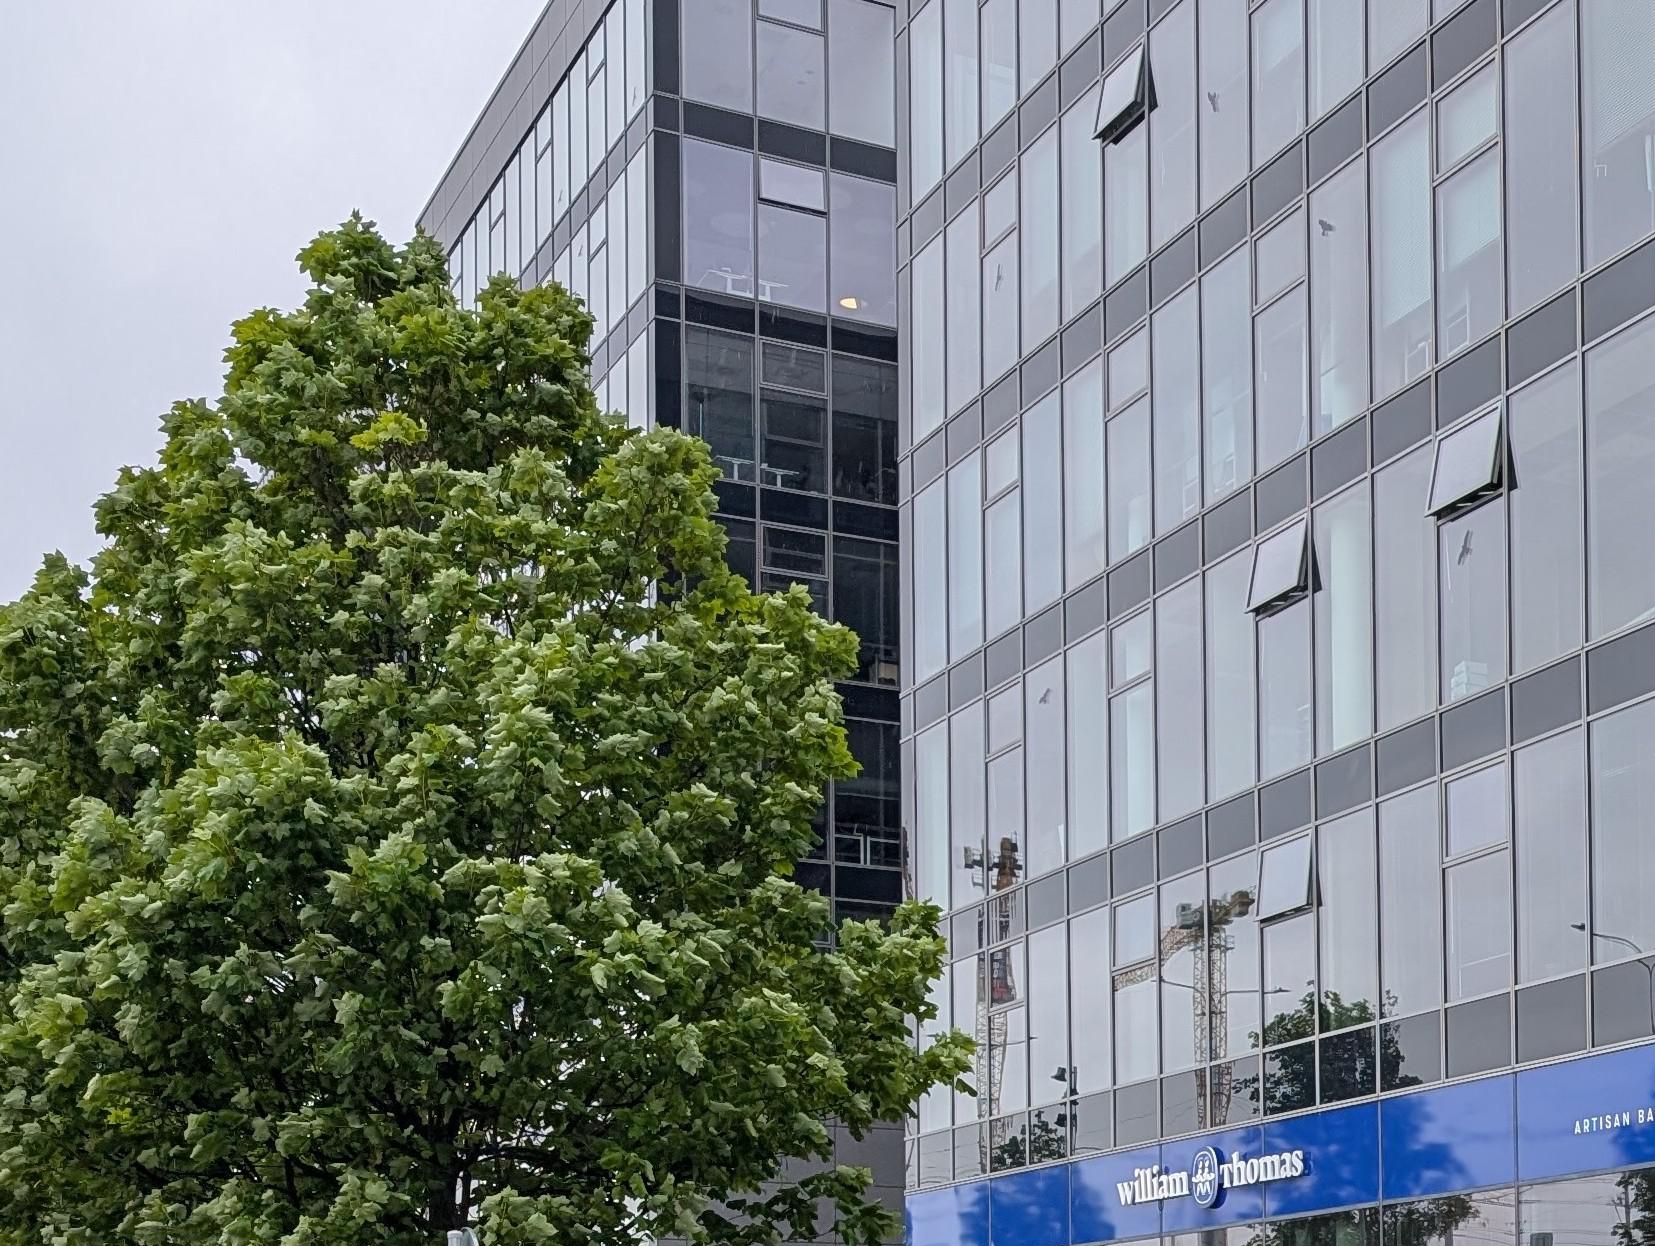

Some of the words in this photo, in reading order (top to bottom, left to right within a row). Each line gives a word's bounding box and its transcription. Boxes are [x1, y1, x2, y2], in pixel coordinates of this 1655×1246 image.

[1574, 1111, 1630, 1135] ARTISAN
[1116, 1164, 1190, 1206] william
[1219, 1150, 1304, 1189] Thomas
